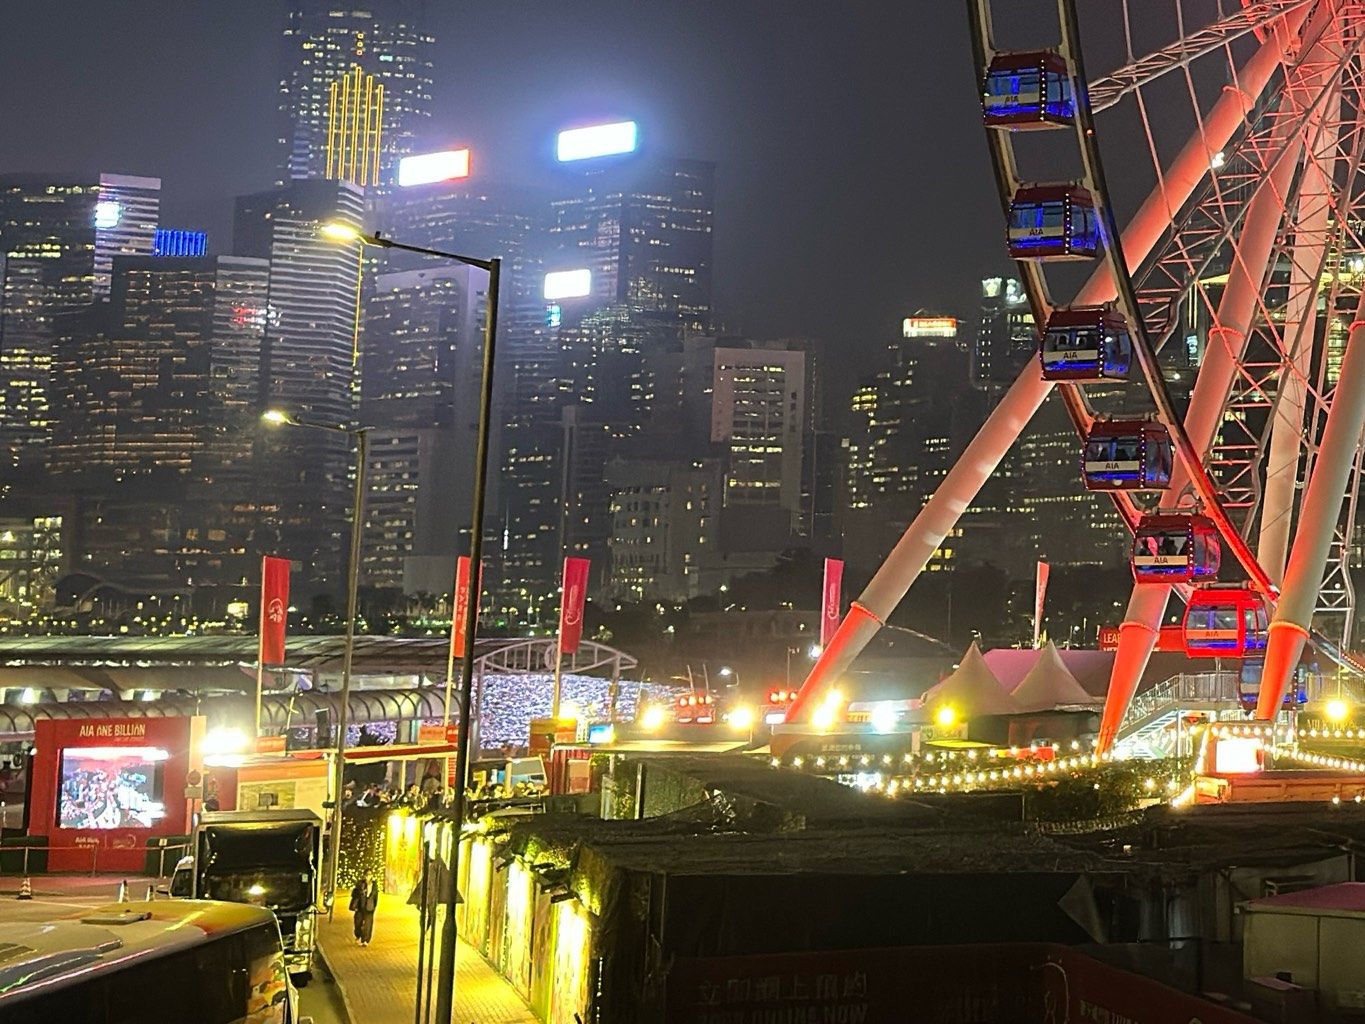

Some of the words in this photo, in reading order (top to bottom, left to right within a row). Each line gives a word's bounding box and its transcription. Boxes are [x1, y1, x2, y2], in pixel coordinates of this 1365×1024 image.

[79, 725, 94, 737] AIA
[96, 724, 113, 737] ONE
[115, 724, 146, 737] BILLION
